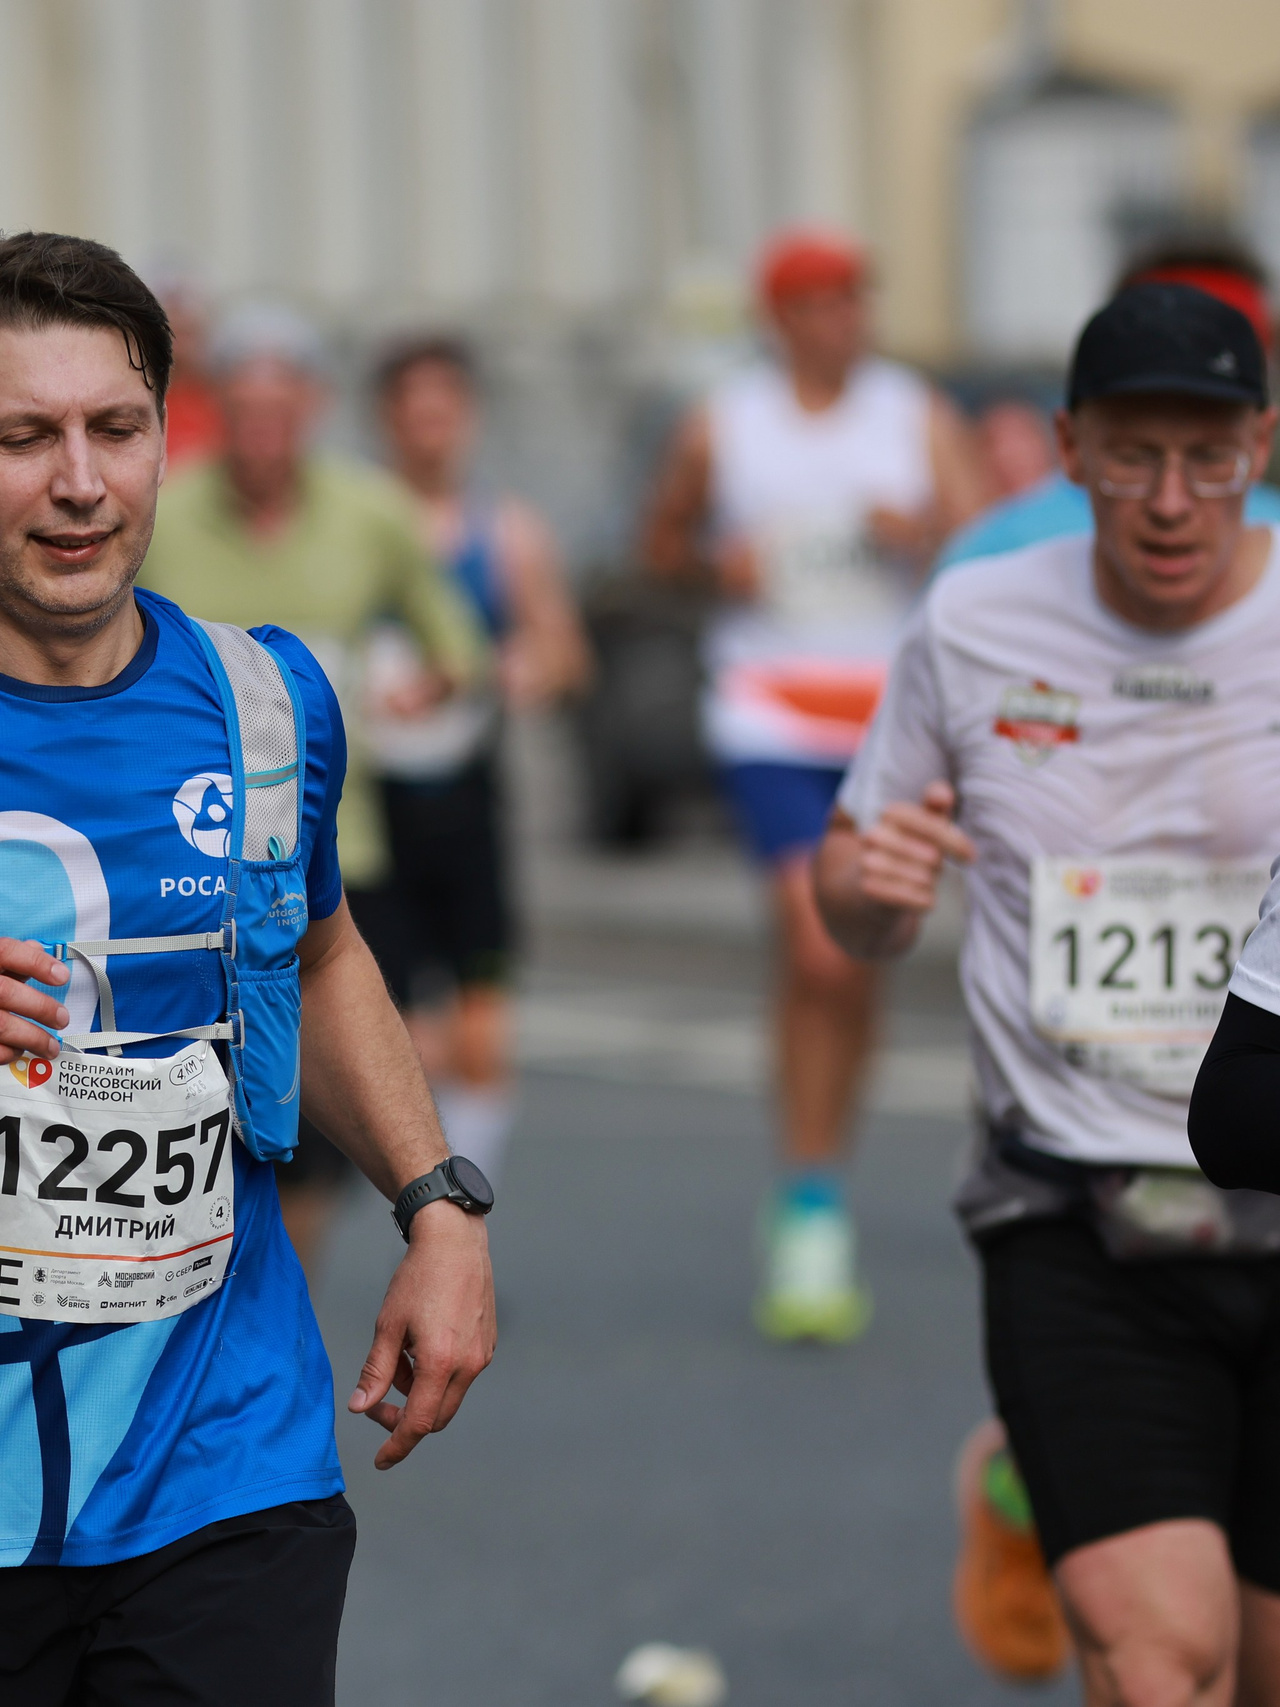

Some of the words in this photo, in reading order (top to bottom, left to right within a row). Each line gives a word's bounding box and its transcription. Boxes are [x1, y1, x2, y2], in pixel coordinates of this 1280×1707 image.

[267, 906, 299, 918] utdoor
[1053, 923, 1260, 990] 1213
[60, 1060, 135, 1077] СБЕРПРАЙМ
[58, 1072, 162, 1091] МОСКОВСКИЙ
[58, 1084, 133, 1103] МАРАФОН
[216, 1205, 224, 1219] 4
[54, 1214, 176, 1240] ДМИТРИЙ
[115, 1270, 156, 1281] МОСКОВСКИЙ
[176, 1265, 192, 1278] СБЕР
[114, 1280, 134, 1288] СПОРТ
[68, 1302, 90, 1310] BRICS
[109, 1300, 147, 1309] магнит
